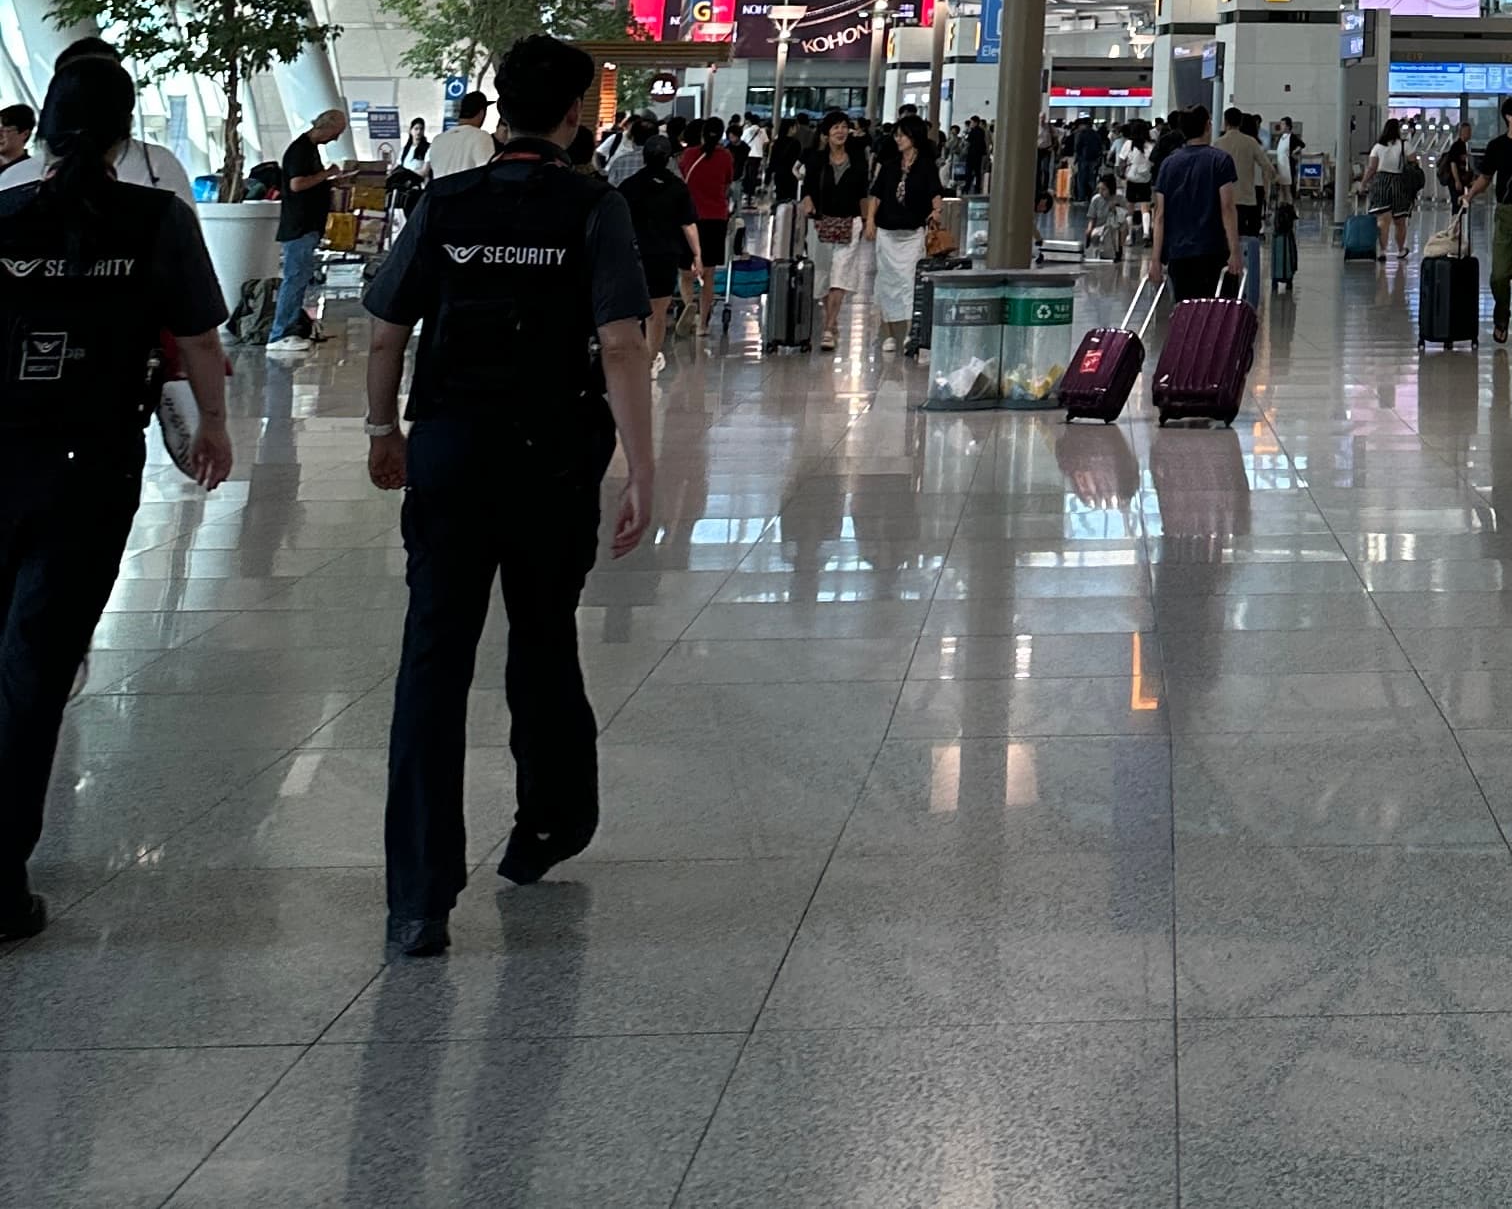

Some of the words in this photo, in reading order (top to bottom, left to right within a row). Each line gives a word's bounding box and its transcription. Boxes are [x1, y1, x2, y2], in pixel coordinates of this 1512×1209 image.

[693, 1, 711, 21] G
[802, 21, 873, 54] KOHON
[482, 246, 567, 265] SECURITY
[44, 258, 135, 277] SERITY
